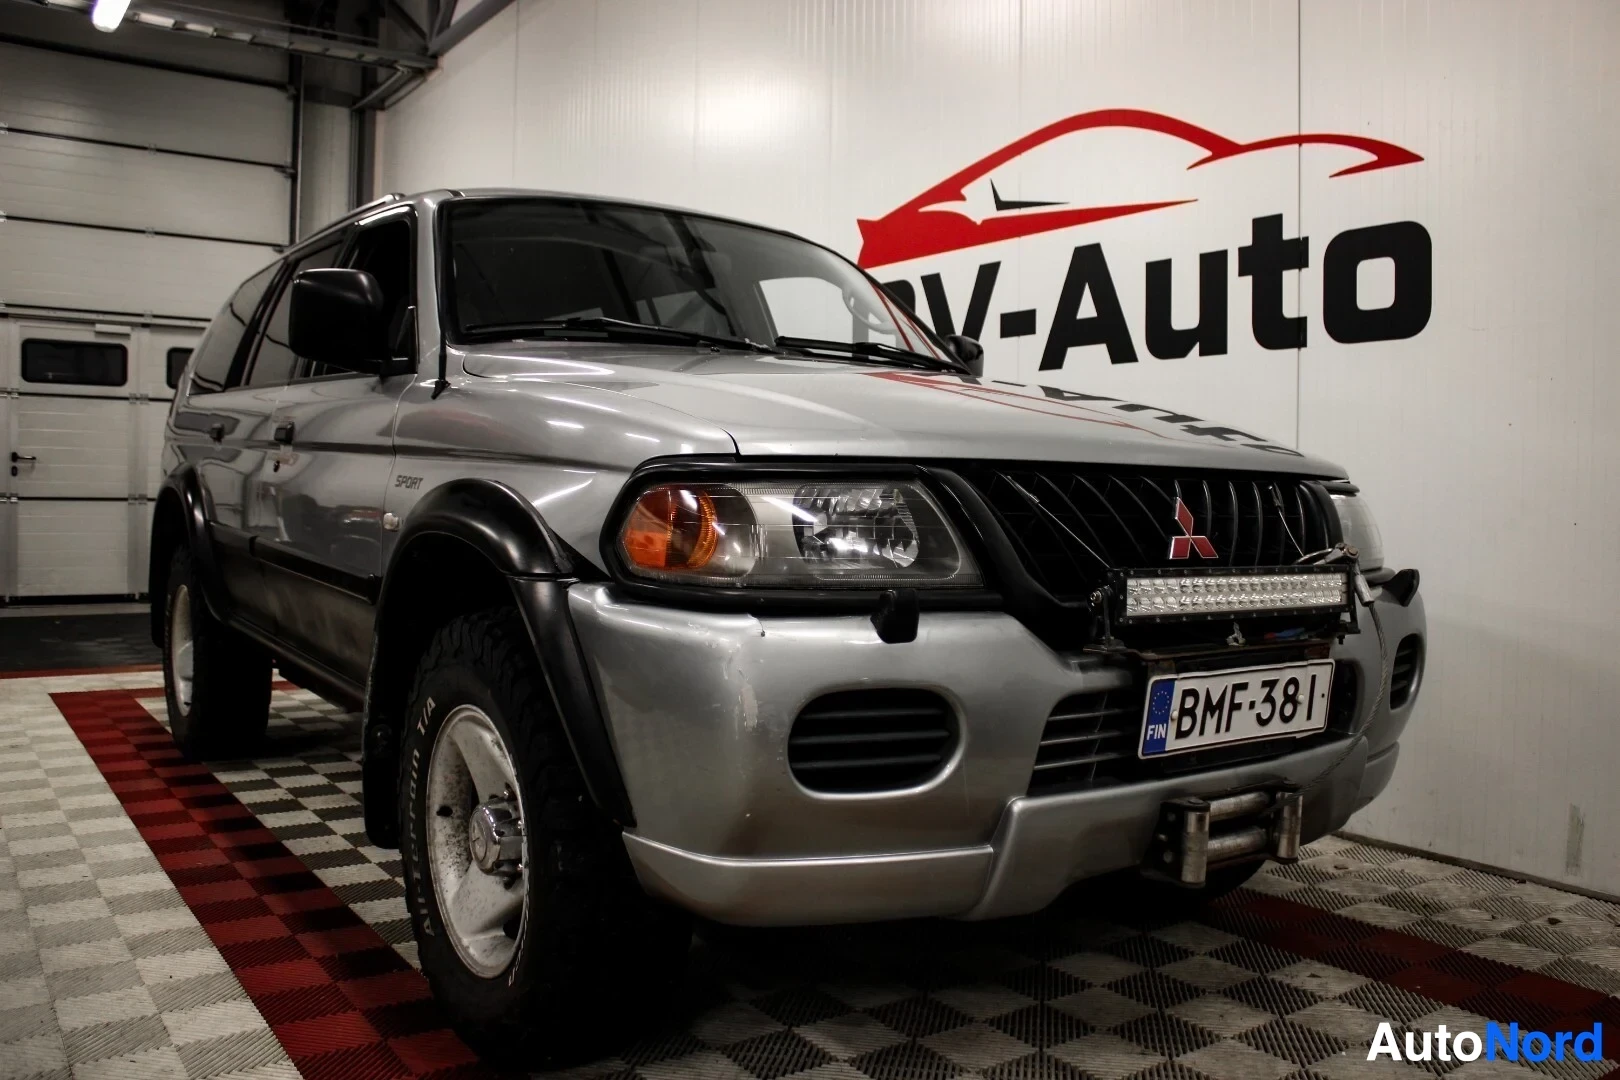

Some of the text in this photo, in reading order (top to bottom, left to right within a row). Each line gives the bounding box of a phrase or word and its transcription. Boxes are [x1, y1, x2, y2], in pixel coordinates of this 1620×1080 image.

[395, 474, 424, 490] SPORT
[416, 696, 436, 736] T/A
[1174, 674, 1317, 740] BMF-381
[1146, 723, 1167, 741] FIN
